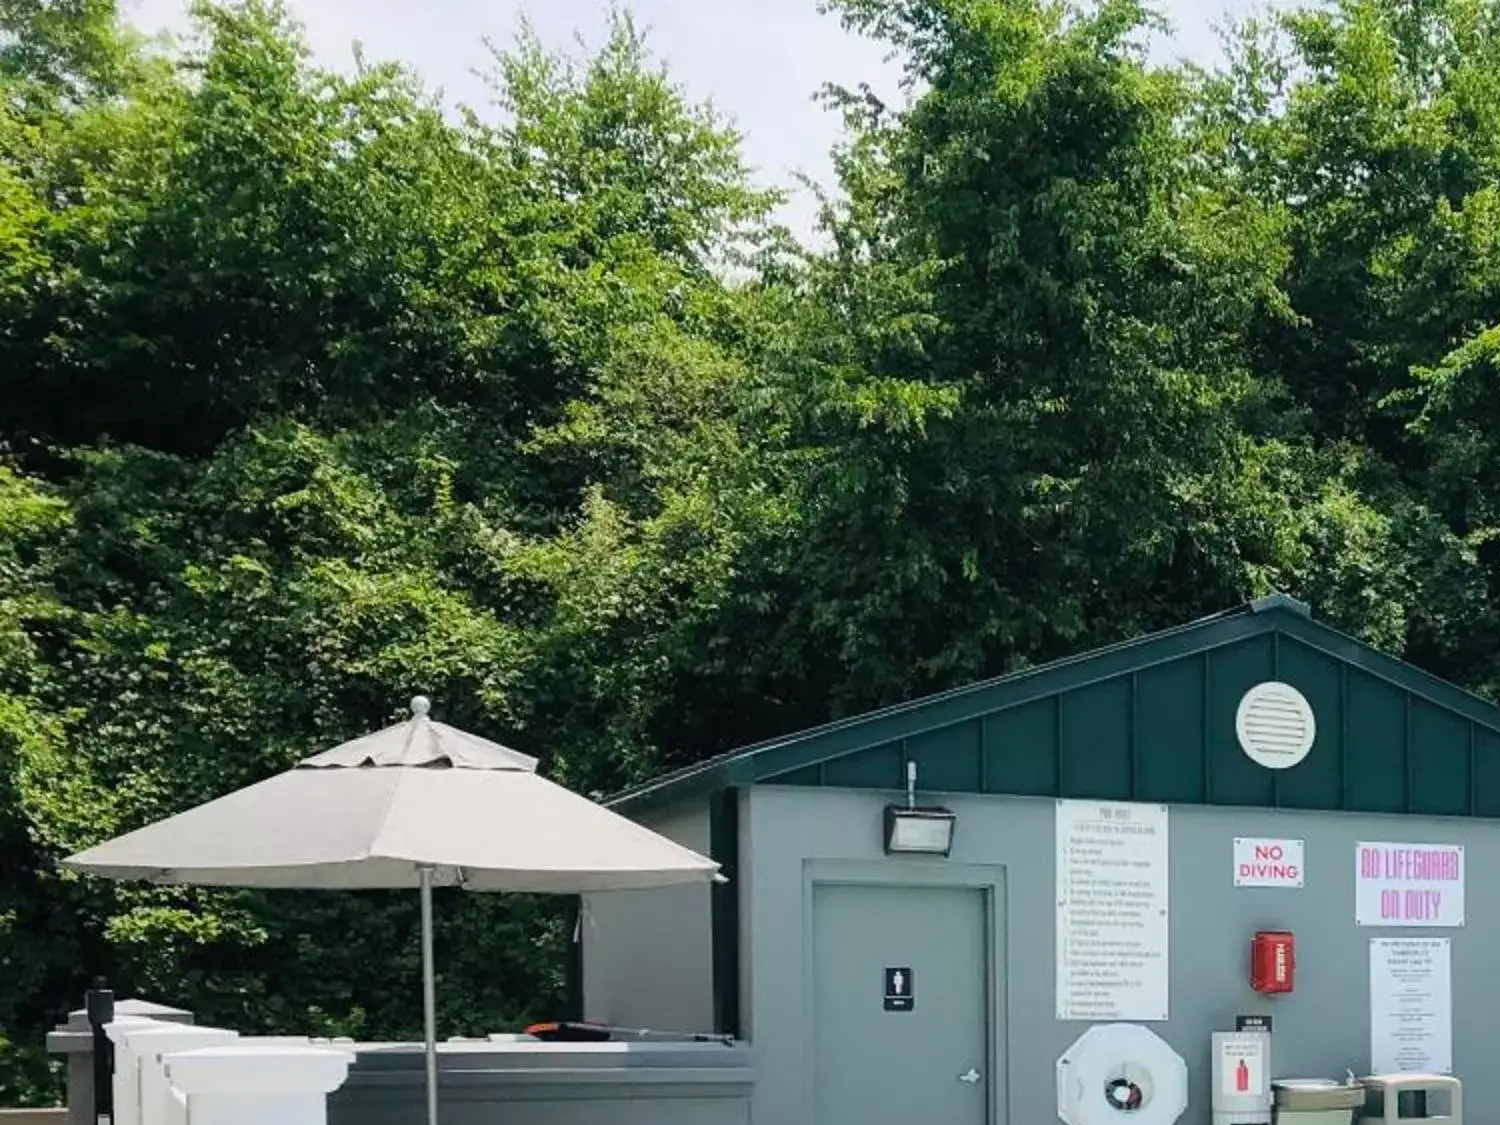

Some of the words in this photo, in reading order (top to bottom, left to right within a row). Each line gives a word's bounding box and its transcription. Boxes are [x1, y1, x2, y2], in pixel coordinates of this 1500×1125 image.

[1255, 845, 1283, 861] NO
[1361, 848, 1379, 879] NO
[1385, 849, 1459, 880] LIFEGUARD
[1239, 863, 1299, 879] DIVING
[1381, 889, 1399, 919] ON
[1405, 889, 1441, 920] DUTY
